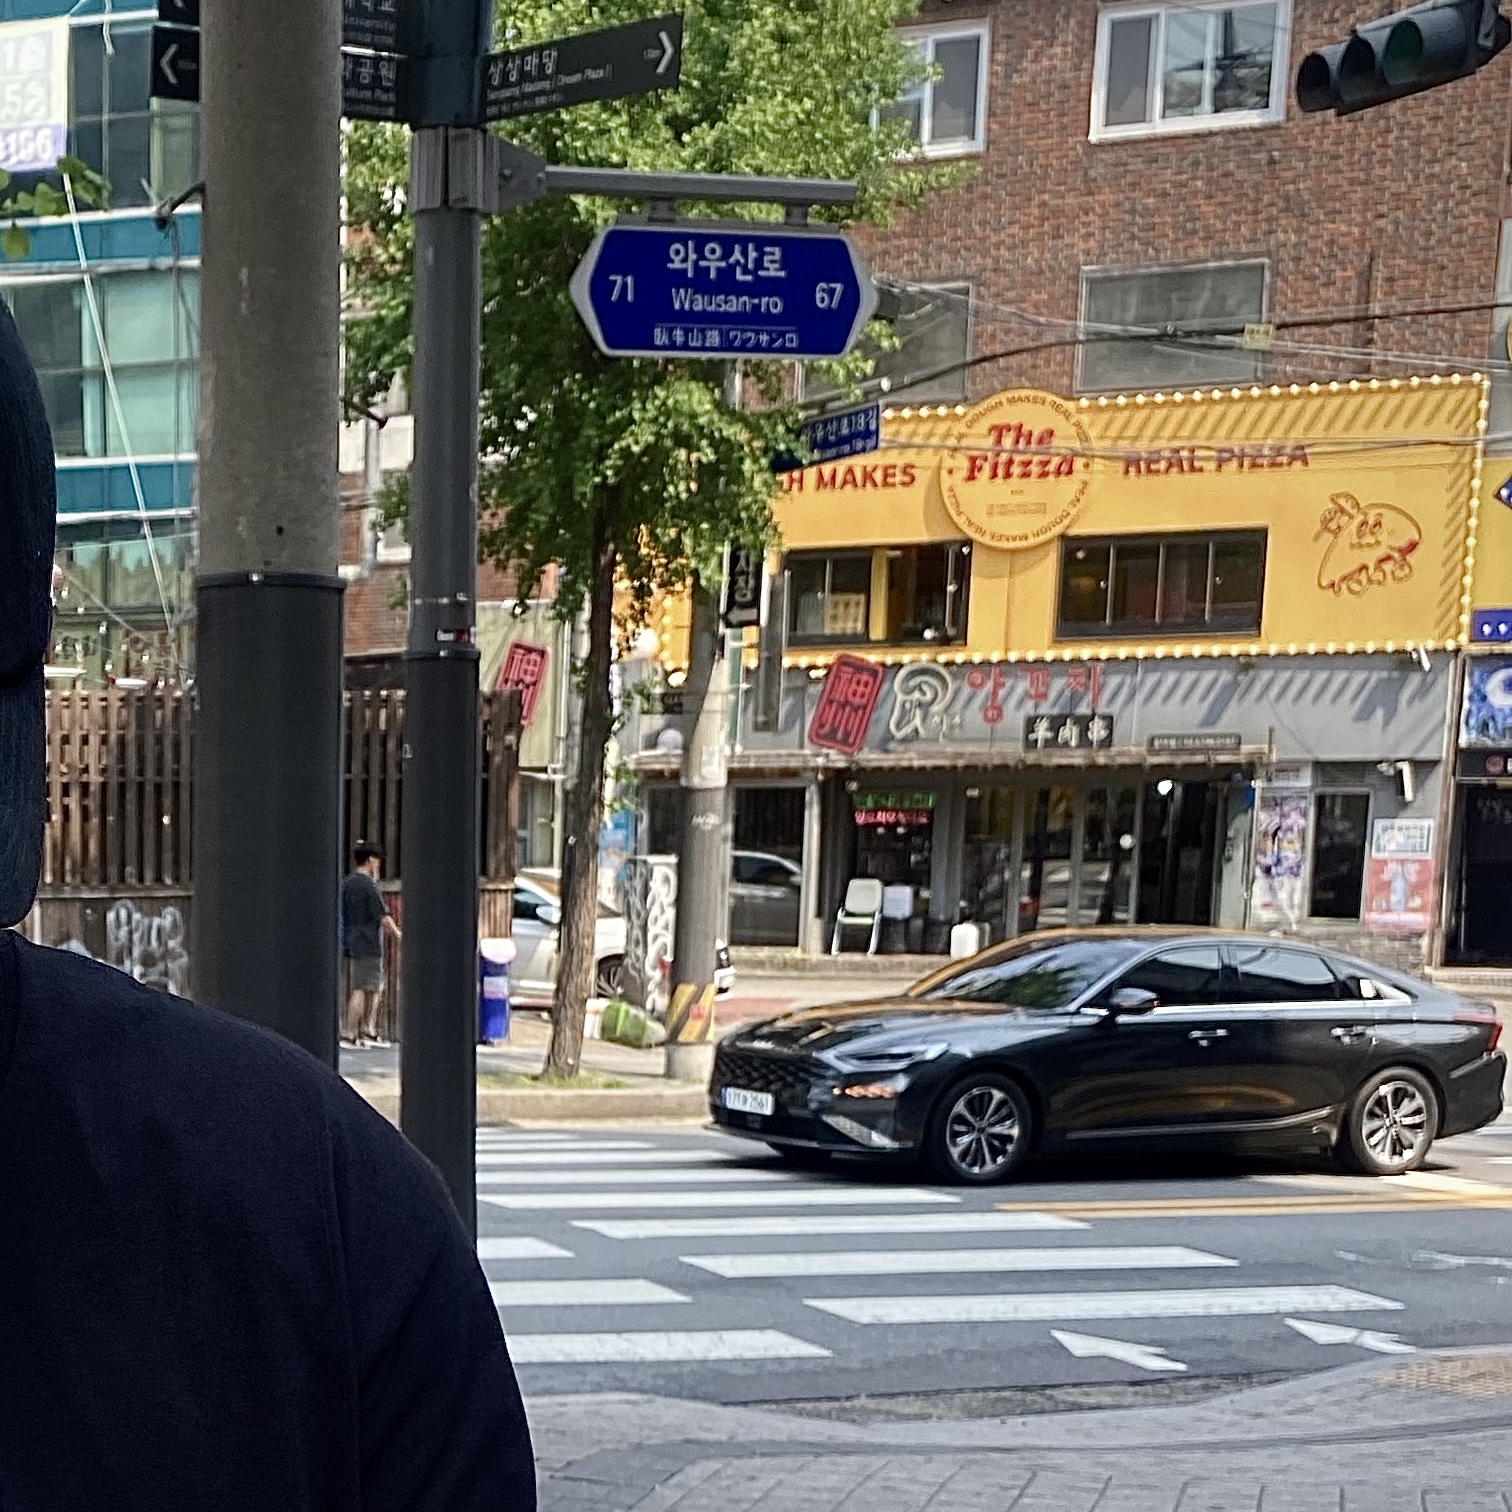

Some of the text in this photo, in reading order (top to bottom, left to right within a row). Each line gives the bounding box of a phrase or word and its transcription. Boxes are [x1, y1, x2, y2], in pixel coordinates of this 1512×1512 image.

[489, 49, 557, 86] 상상마당
[667, 240, 787, 283] 와우산로
[608, 274, 635, 303] 71
[671, 287, 784, 315] Wausan-ro
[815, 282, 844, 310] 67
[988, 421, 1055, 451] The
[963, 452, 1076, 482] Fitzza
[1123, 444, 1309, 476] REAL PIZZA
[816, 463, 916, 492] MAKES
[965, 663, 1105, 725] 양꼬치
[1028, 714, 1110, 750] 羊肉串
